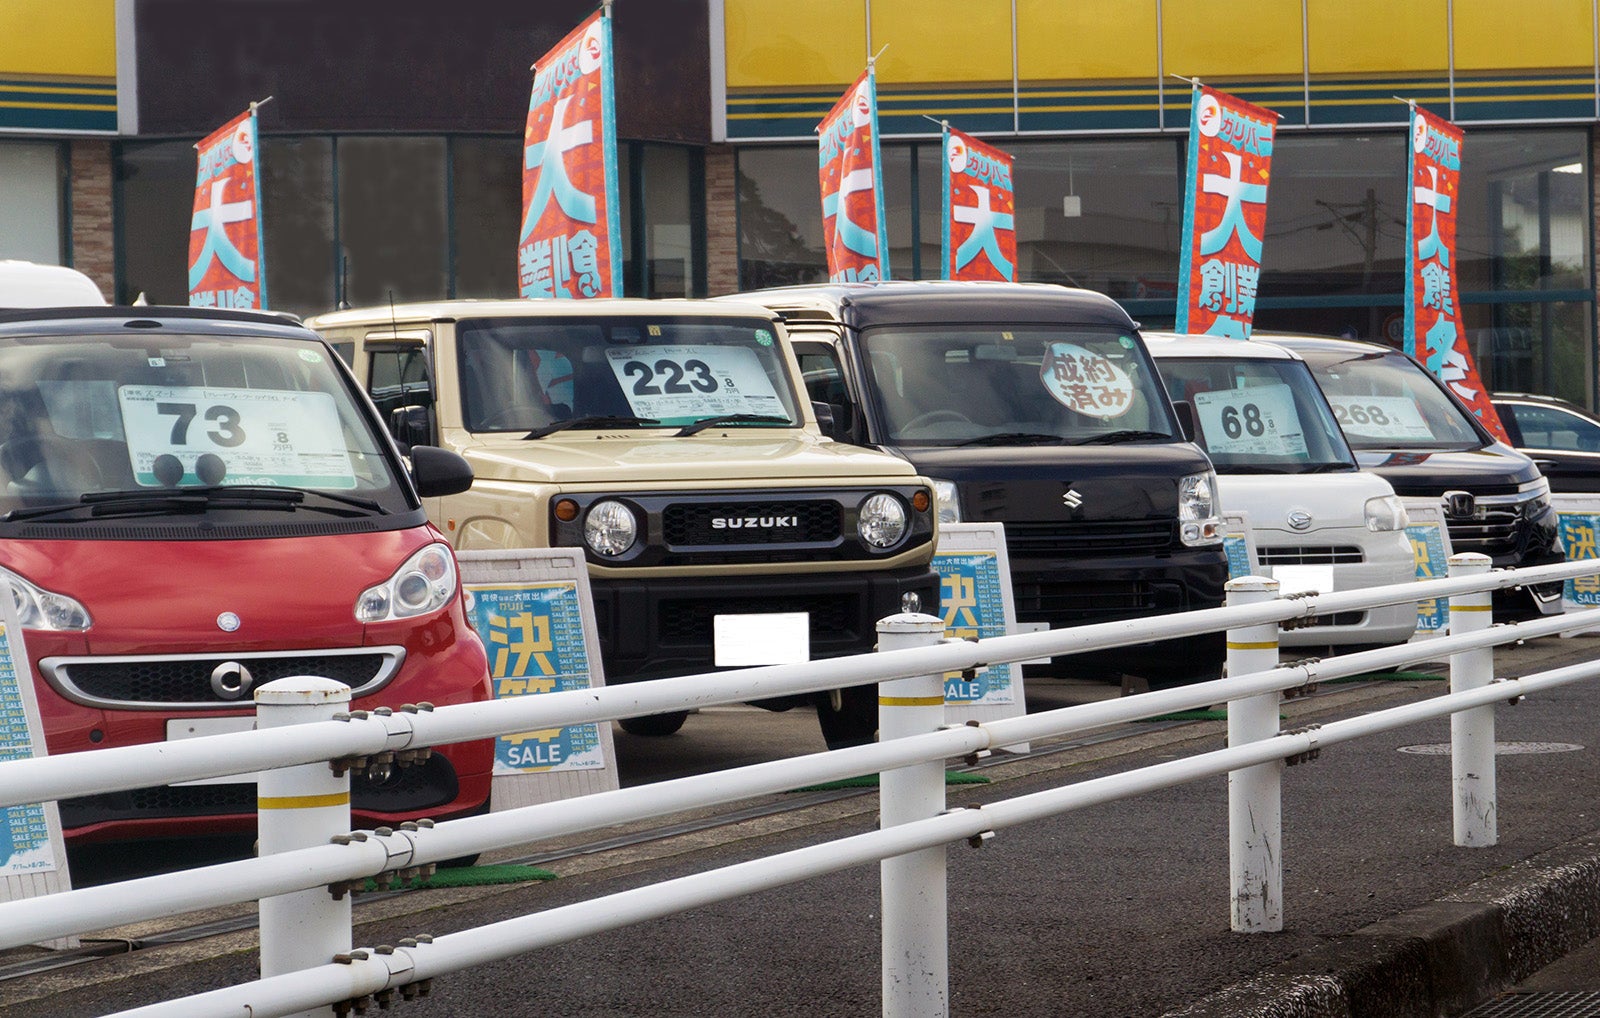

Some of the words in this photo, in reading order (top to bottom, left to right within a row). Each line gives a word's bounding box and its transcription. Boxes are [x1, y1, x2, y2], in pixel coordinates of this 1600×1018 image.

[1220, 116, 1272, 148] ガリバー
[1201, 151, 1268, 264] 大
[953, 185, 1014, 282] 大
[1199, 258, 1261, 315] 創業
[623, 359, 718, 396] 223
[1054, 353, 1117, 383] 成約
[1060, 384, 1128, 410] 済み
[157, 402, 246, 448] 73
[1221, 403, 1265, 440] 68
[1331, 404, 1390, 426] 268
[711, 516, 798, 529] SUZUKI
[1577, 594, 1600, 604] SALE
[1417, 617, 1438, 629] ALE
[507, 744, 561, 767] SALE
